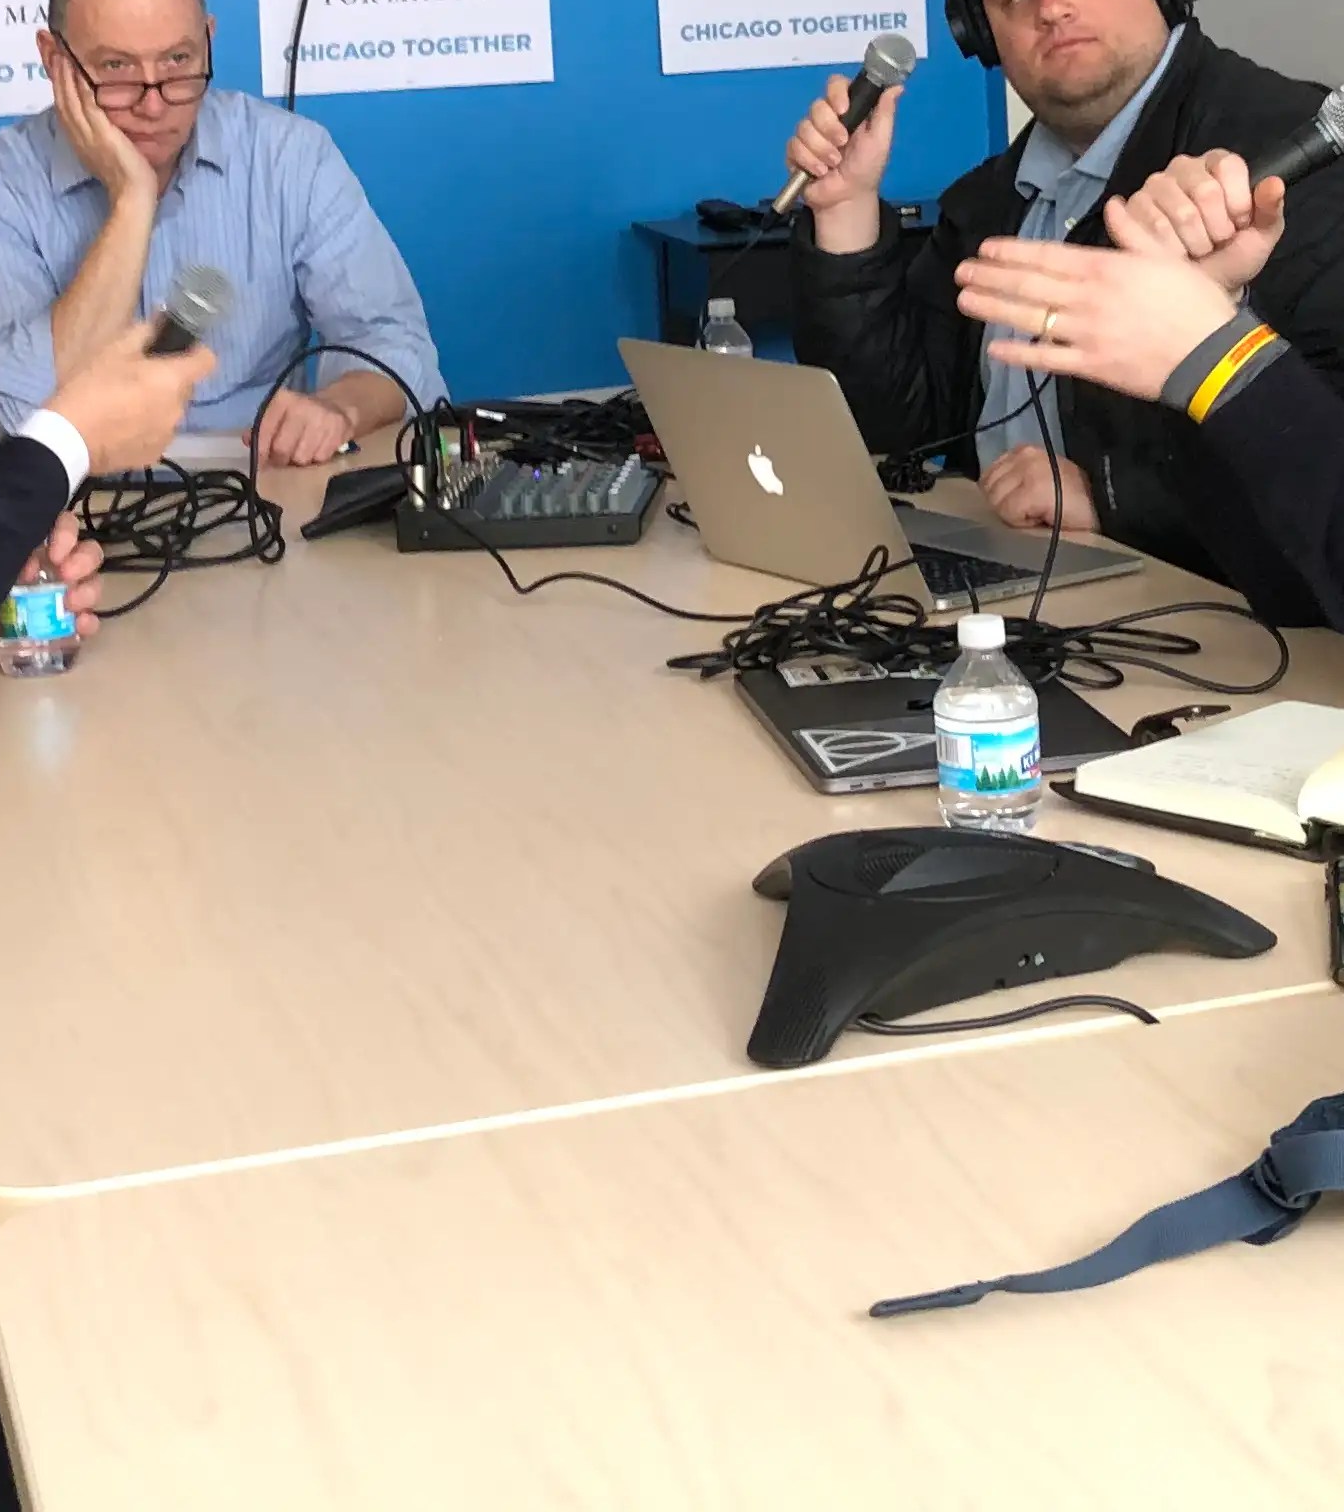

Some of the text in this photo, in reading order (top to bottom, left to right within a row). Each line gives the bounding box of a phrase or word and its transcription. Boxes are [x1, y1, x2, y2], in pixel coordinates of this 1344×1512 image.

[680, 11, 908, 43] CHICAGO TOGETHER
[283, 33, 532, 63] CHICAGO TOGETHER
